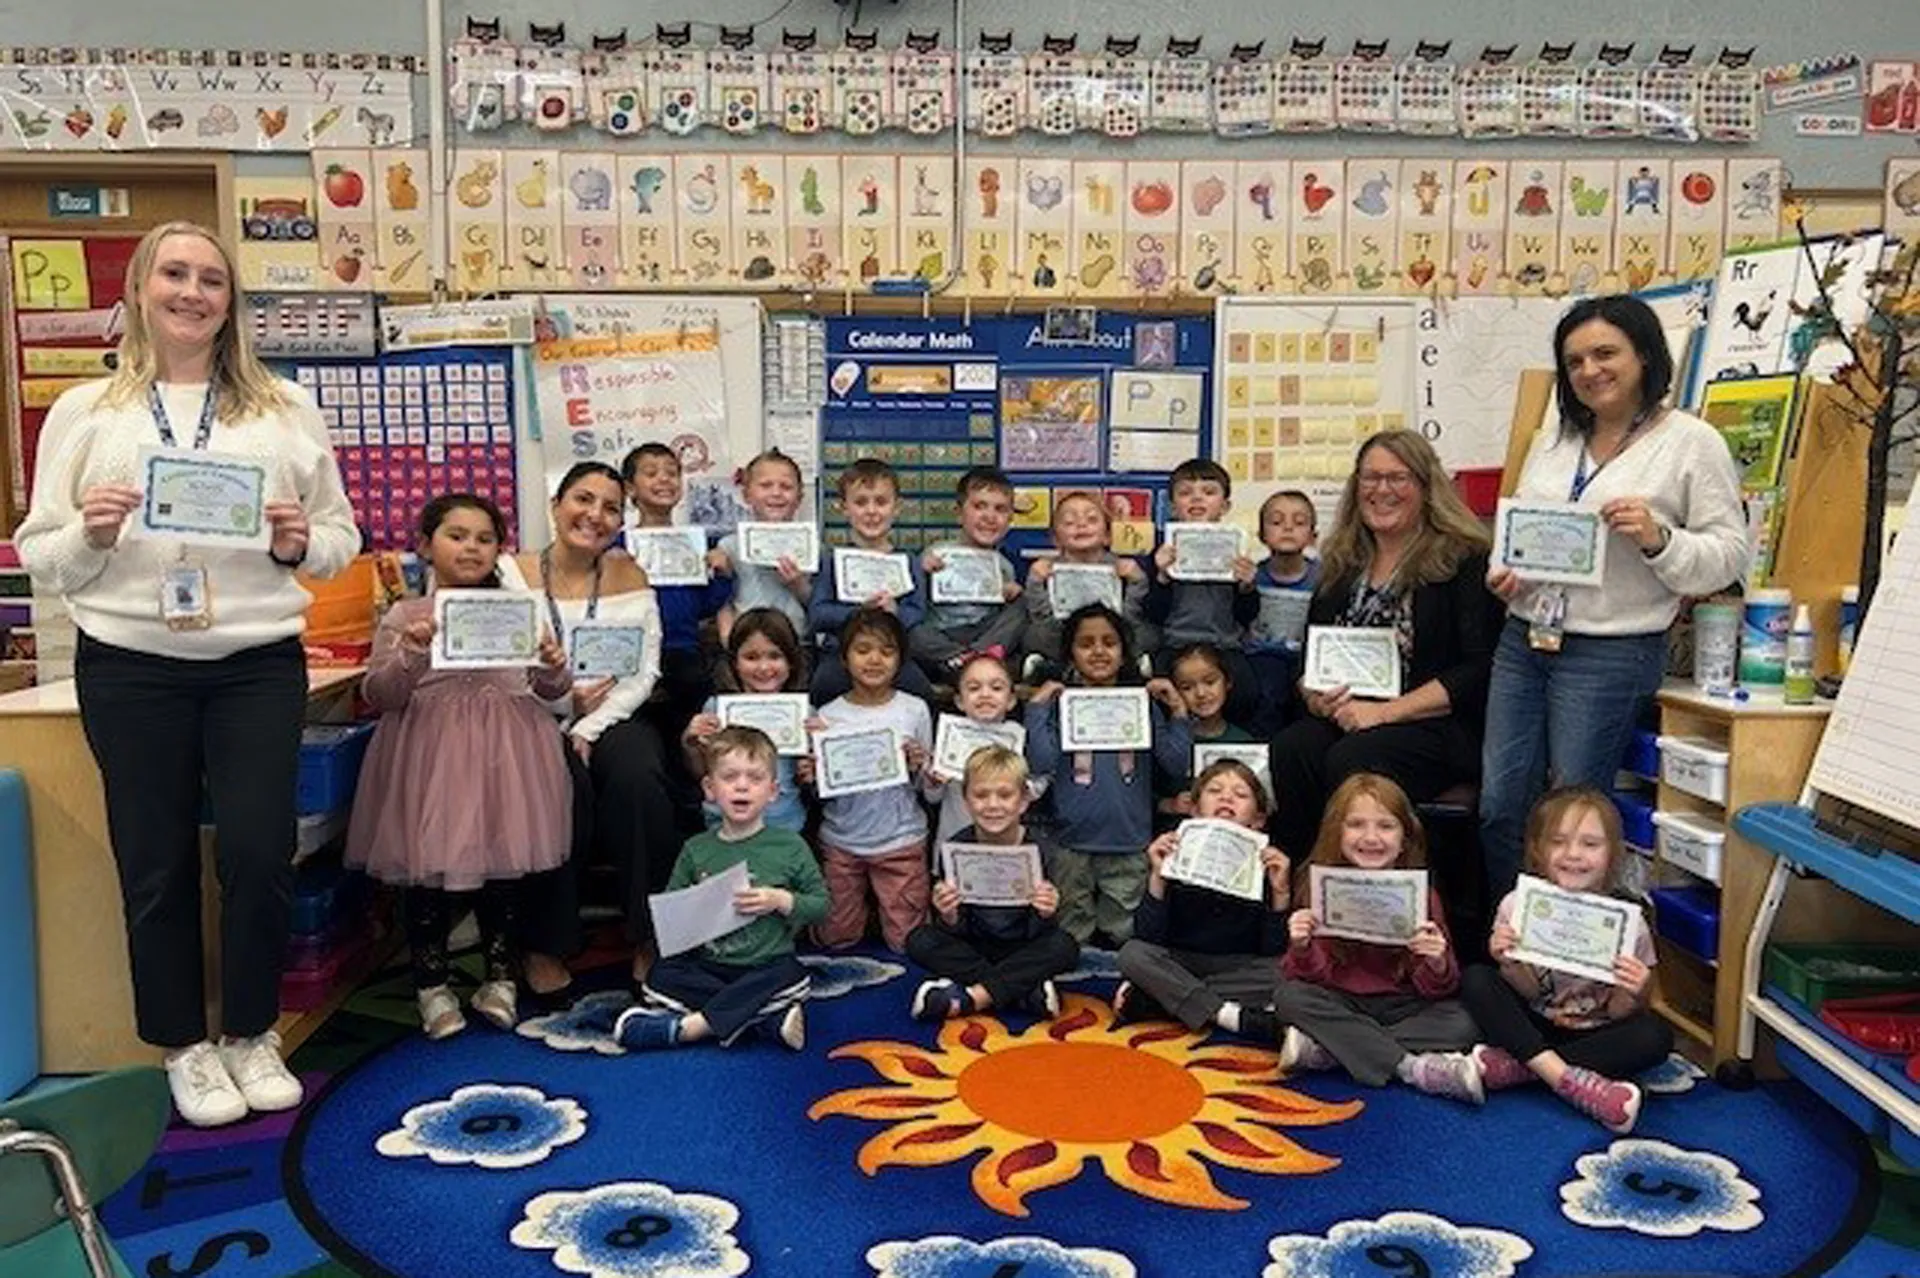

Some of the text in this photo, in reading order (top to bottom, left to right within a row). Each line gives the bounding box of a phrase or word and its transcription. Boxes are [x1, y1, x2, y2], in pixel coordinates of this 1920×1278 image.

[151, 70, 178, 91] Vv
[198, 70, 237, 91] Ww
[255, 71, 283, 92] Xx
[306, 71, 337, 101] Yy
[361, 72, 385, 94] Zz
[336, 226, 360, 244] Aa
[581, 228, 604, 247] Ee
[692, 229, 721, 255] Gg
[748, 230, 771, 247] Hh
[917, 230, 936, 248] Kk
[980, 232, 996, 250] Ll
[1028, 232, 1063, 250] Mm
[1086, 232, 1111, 250] Nn
[1137, 233, 1164, 252] Oo
[1732, 259, 1759, 281] Rr
[1420, 309, 1438, 330] a
[849, 331, 973, 348] Calendar Math
[1421, 345, 1438, 366] e
[560, 364, 675, 394] Responsible
[1424, 381, 1434, 406] i
[1422, 420, 1441, 441] o
[604, 1215, 672, 1248] 8
